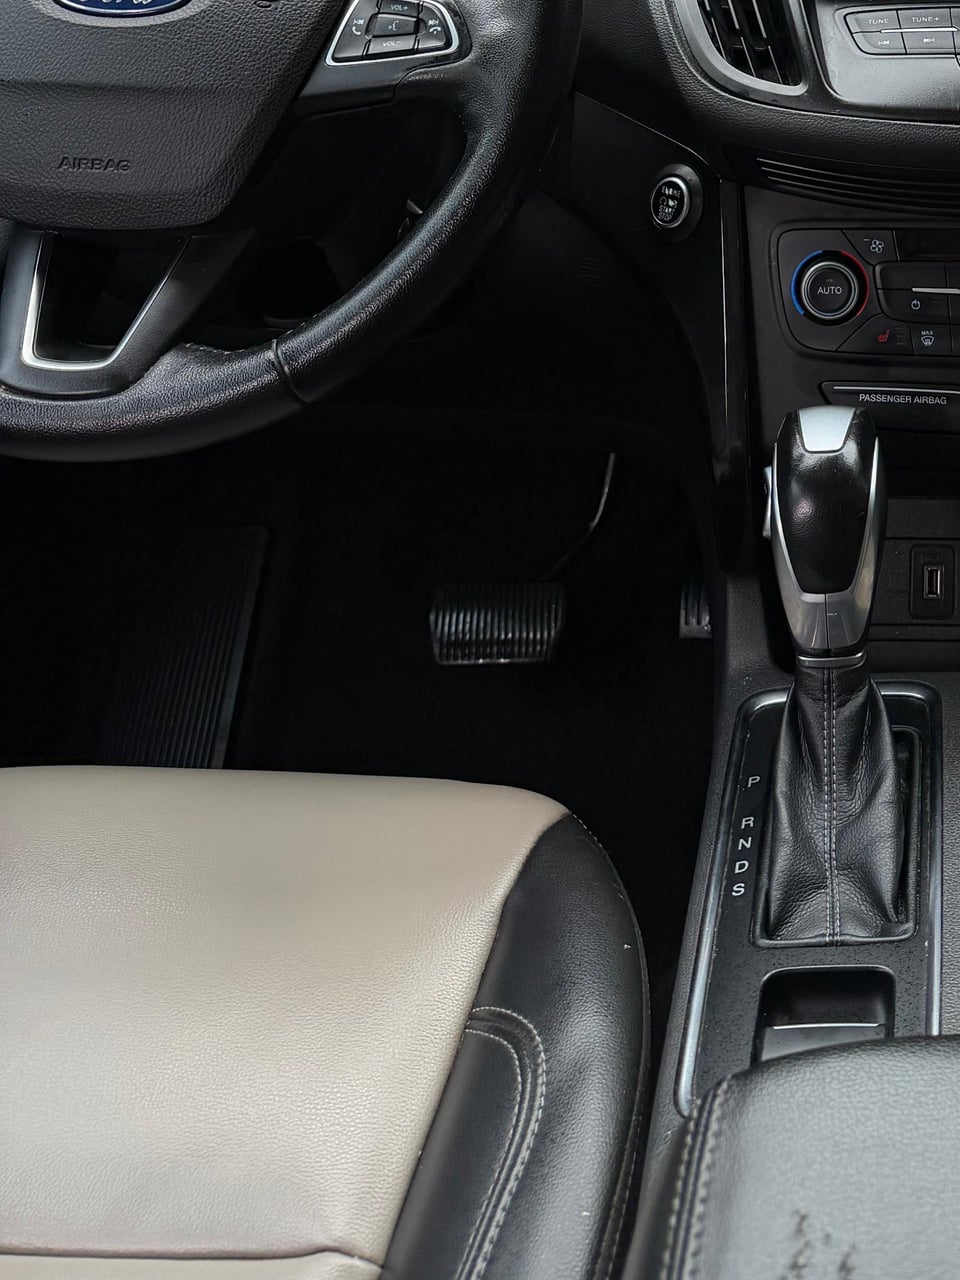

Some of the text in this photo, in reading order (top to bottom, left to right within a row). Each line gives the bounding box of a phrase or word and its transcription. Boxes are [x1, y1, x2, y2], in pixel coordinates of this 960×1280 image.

[56, 155, 131, 172] AIRBAG
[816, 286, 843, 295] AUTO
[859, 393, 947, 405] PASSENGER AIRBAG
[747, 774, 760, 788] P
[741, 816, 755, 830] R
[738, 836, 752, 851] N
[734, 860, 749, 874] D
[731, 882, 746, 897] S
